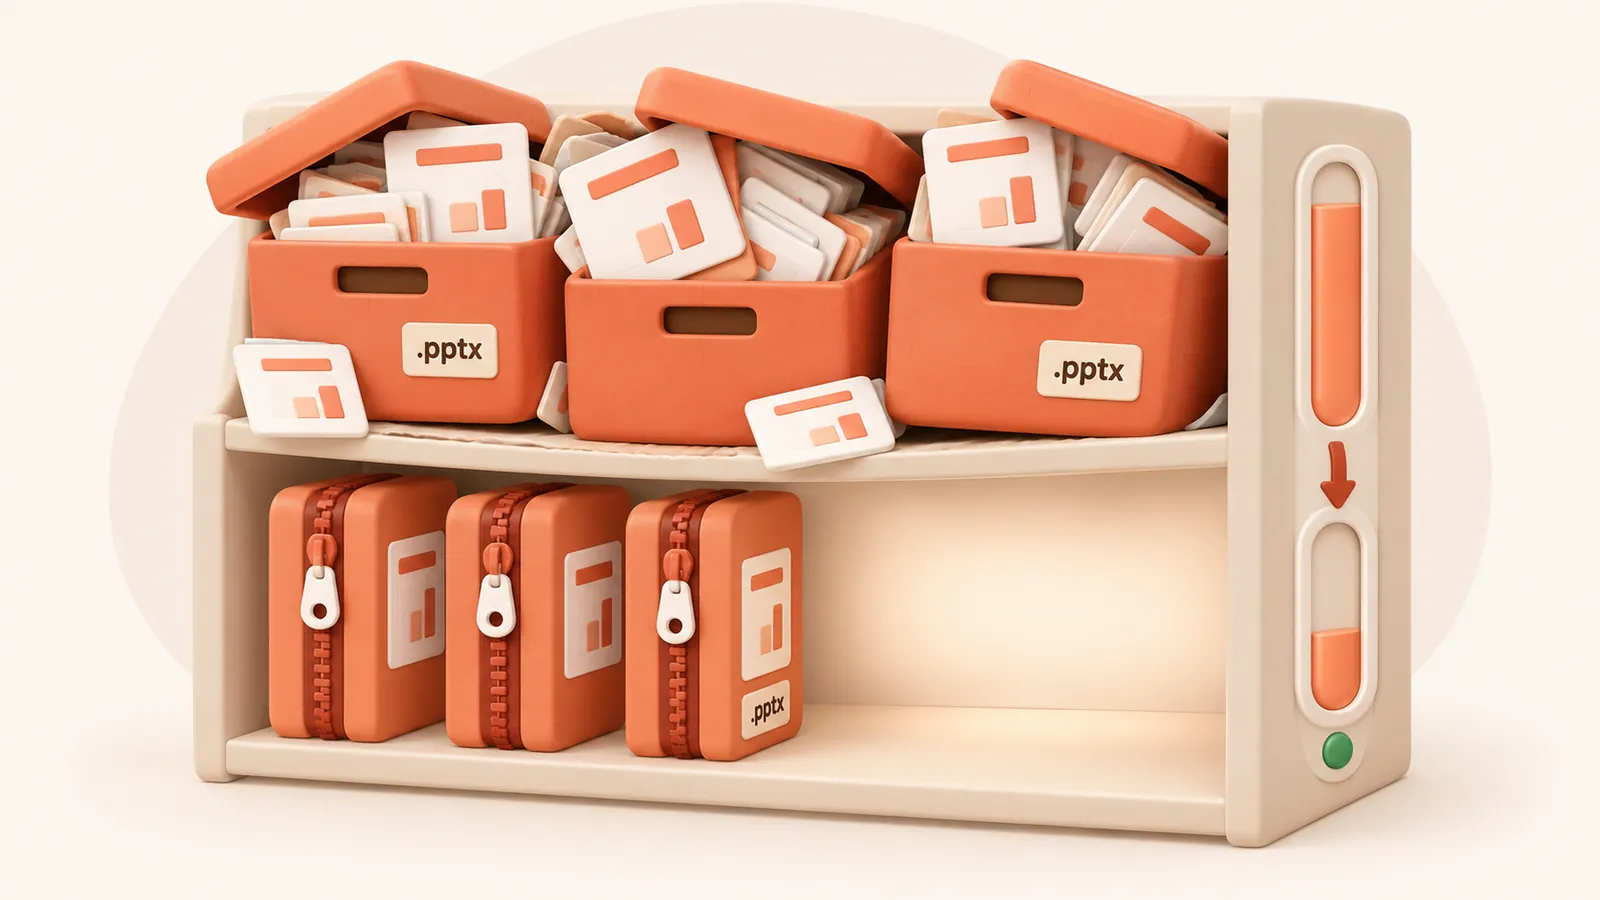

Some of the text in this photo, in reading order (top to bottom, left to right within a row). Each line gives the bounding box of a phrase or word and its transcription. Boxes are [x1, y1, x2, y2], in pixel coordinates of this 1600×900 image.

[416, 338, 483, 365] .pptx
[1054, 358, 1125, 386] .pptx
[750, 695, 785, 726] .pptx
